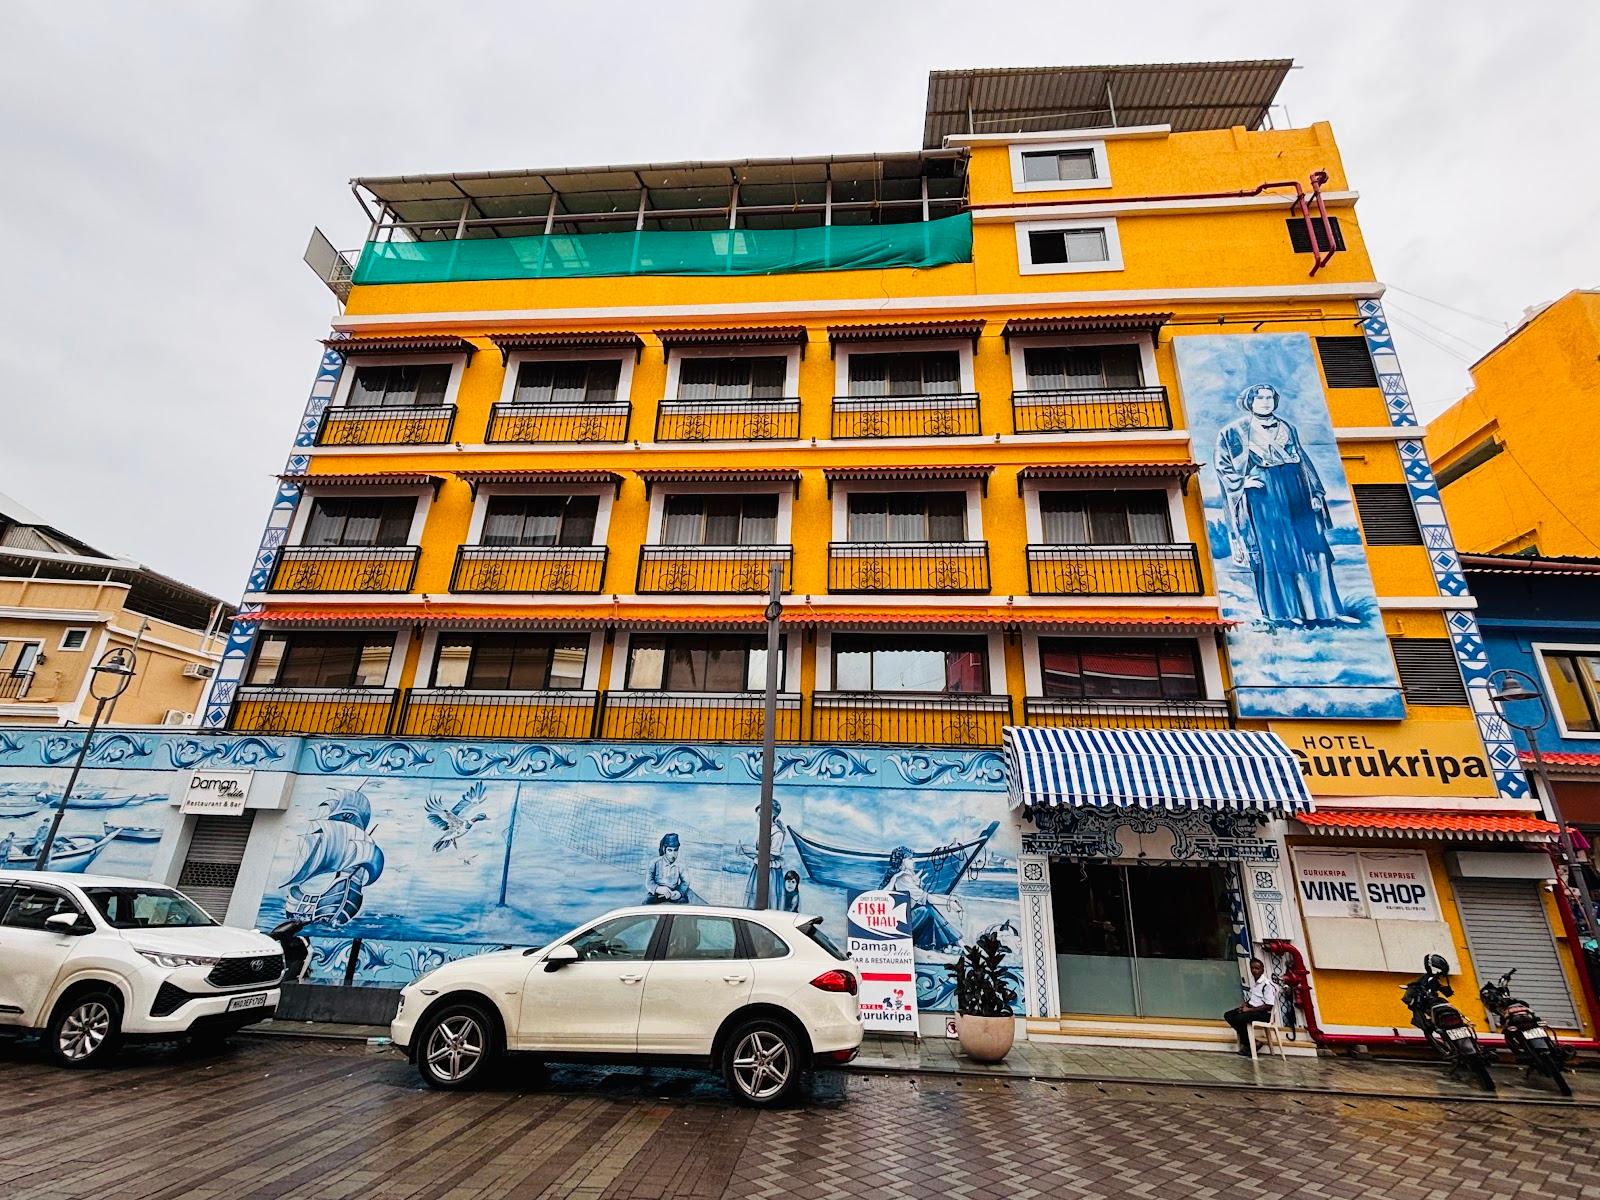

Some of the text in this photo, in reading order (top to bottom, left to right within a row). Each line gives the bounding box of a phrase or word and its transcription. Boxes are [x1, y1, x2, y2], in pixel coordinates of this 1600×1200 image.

[1302, 736, 1374, 749] HOTEL
[1290, 749, 1488, 784] Gurukripa
[190, 776, 238, 789] Daman
[1303, 869, 1416, 879] GURUKRIPA ENTERPRISE
[1301, 880, 1426, 904] WINE SHOP
[857, 902, 886, 915] FISH
[866, 916, 896, 927] THALI
[851, 940, 897, 952] Daman
[860, 1011, 912, 1023] urukripa
